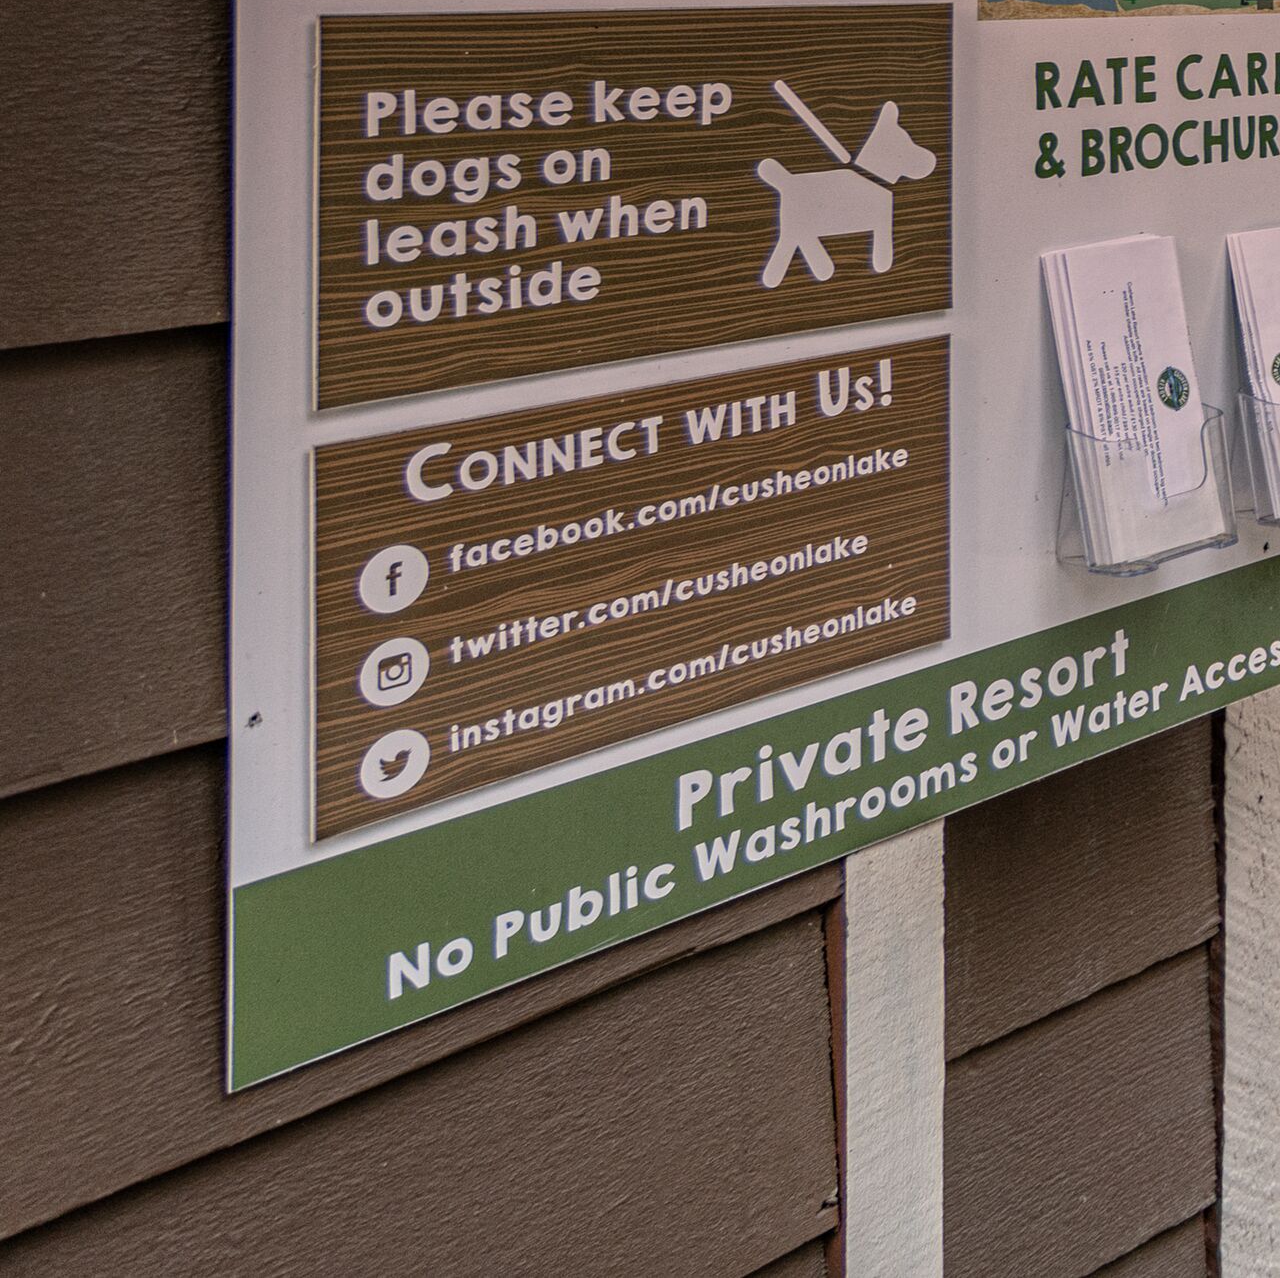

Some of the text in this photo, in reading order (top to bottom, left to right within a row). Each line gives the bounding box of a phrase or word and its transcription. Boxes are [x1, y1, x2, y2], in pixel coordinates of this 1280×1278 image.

[365, 79, 732, 137] Please keep
[1034, 56, 1157, 110] RATE
[364, 147, 612, 203] dogs on
[1034, 132, 1066, 178] &
[366, 196, 707, 265] leash when
[365, 261, 601, 327] outside
[406, 416, 664, 502] CONNECT
[687, 391, 797, 446] WITH
[449, 447, 910, 573] facebook.com/cusheonlake
[450, 534, 869, 665] twitter.com/cusheonlake
[449, 595, 918, 753] instagram.com/cusheonlake
[676, 629, 1130, 831] Private Resort
[388, 939, 474, 1001] No
[495, 865, 677, 961] Public
[694, 752, 981, 880] Washrooms
[992, 725, 1038, 771] or
[1051, 684, 1169, 750] Water
